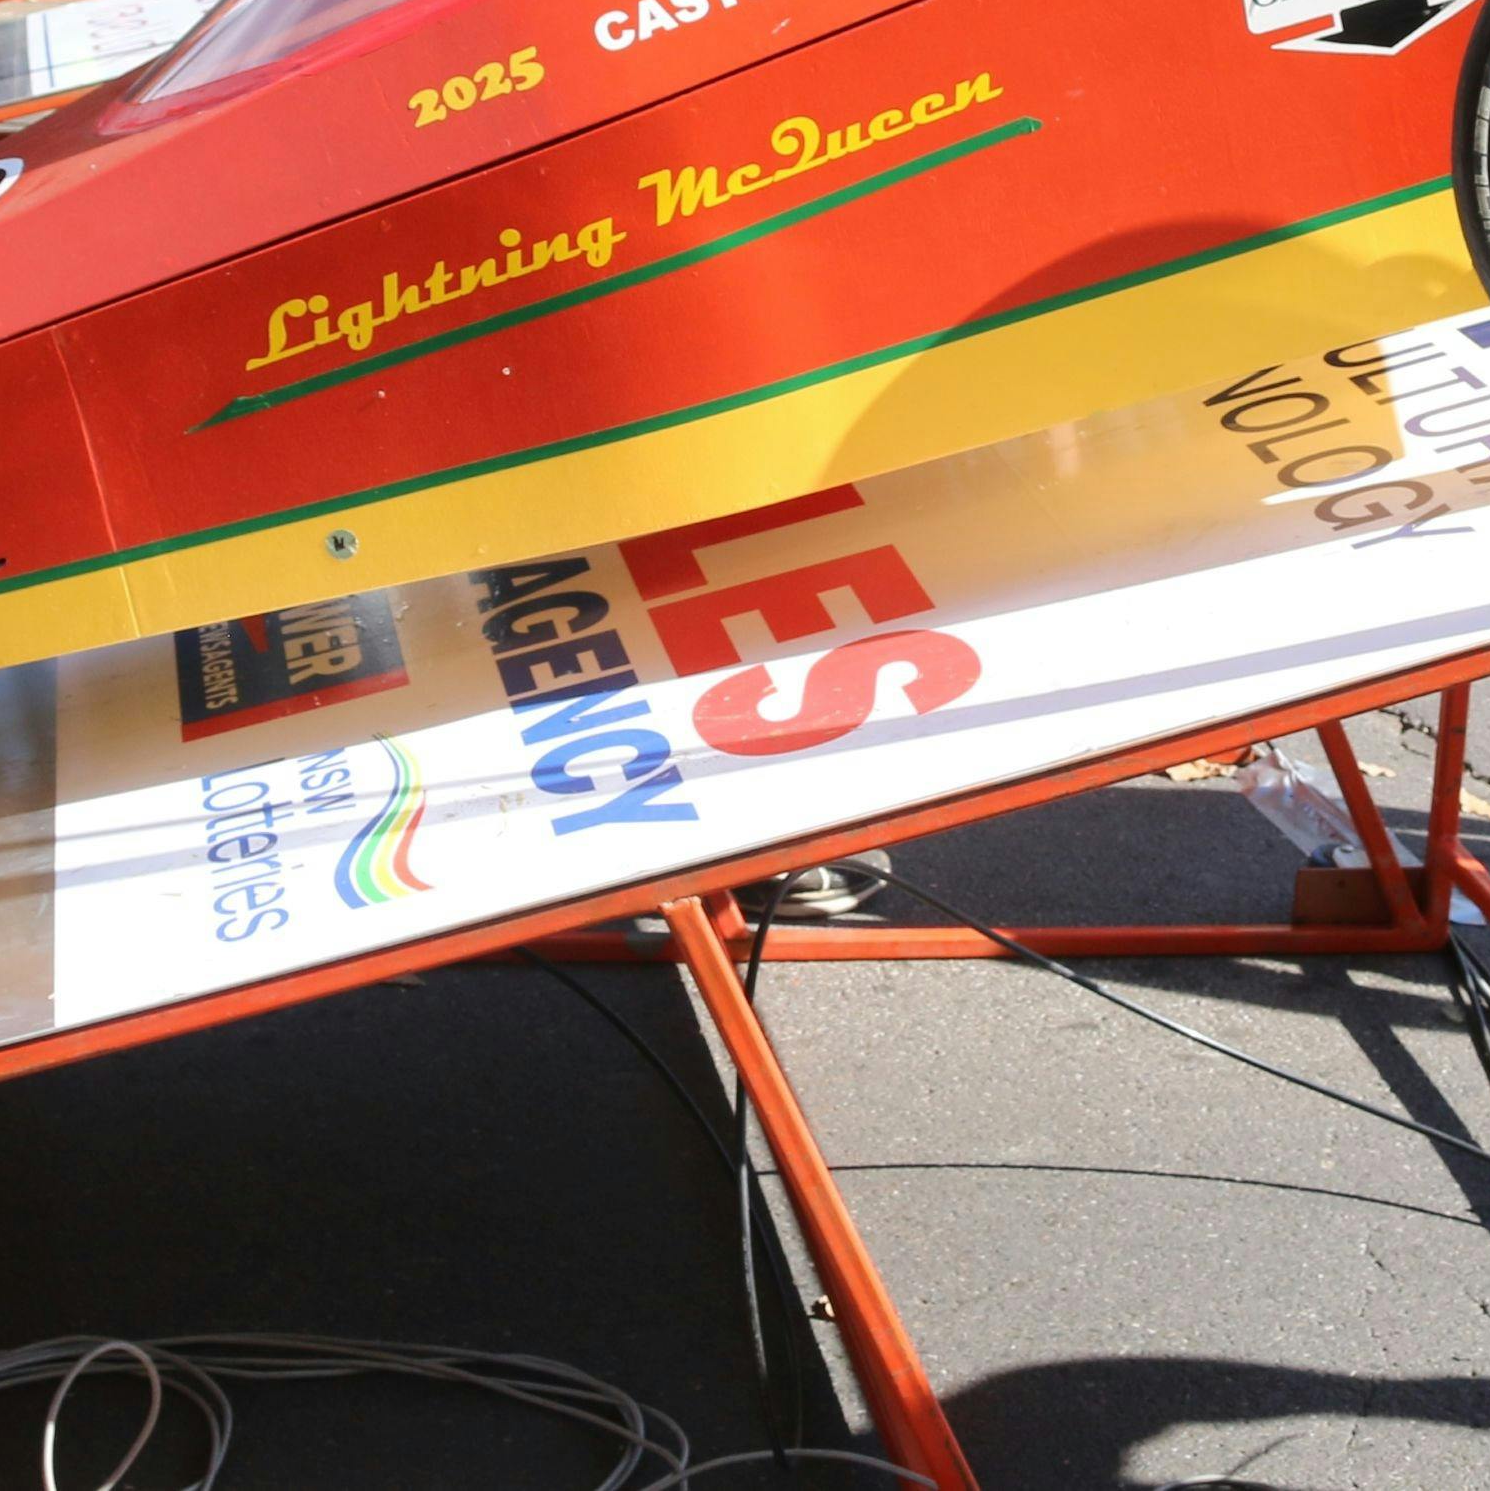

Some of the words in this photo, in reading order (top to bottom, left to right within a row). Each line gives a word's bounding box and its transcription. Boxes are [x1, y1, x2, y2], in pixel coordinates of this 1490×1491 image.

[408, 46, 545, 128] 2025
[246, 214, 627, 371] Lightning
[638, 71, 1004, 228] McQueen
[297, 746, 357, 815] NSW
[469, 556, 700, 836] AGENCY
[201, 757, 305, 942] Lotteries
